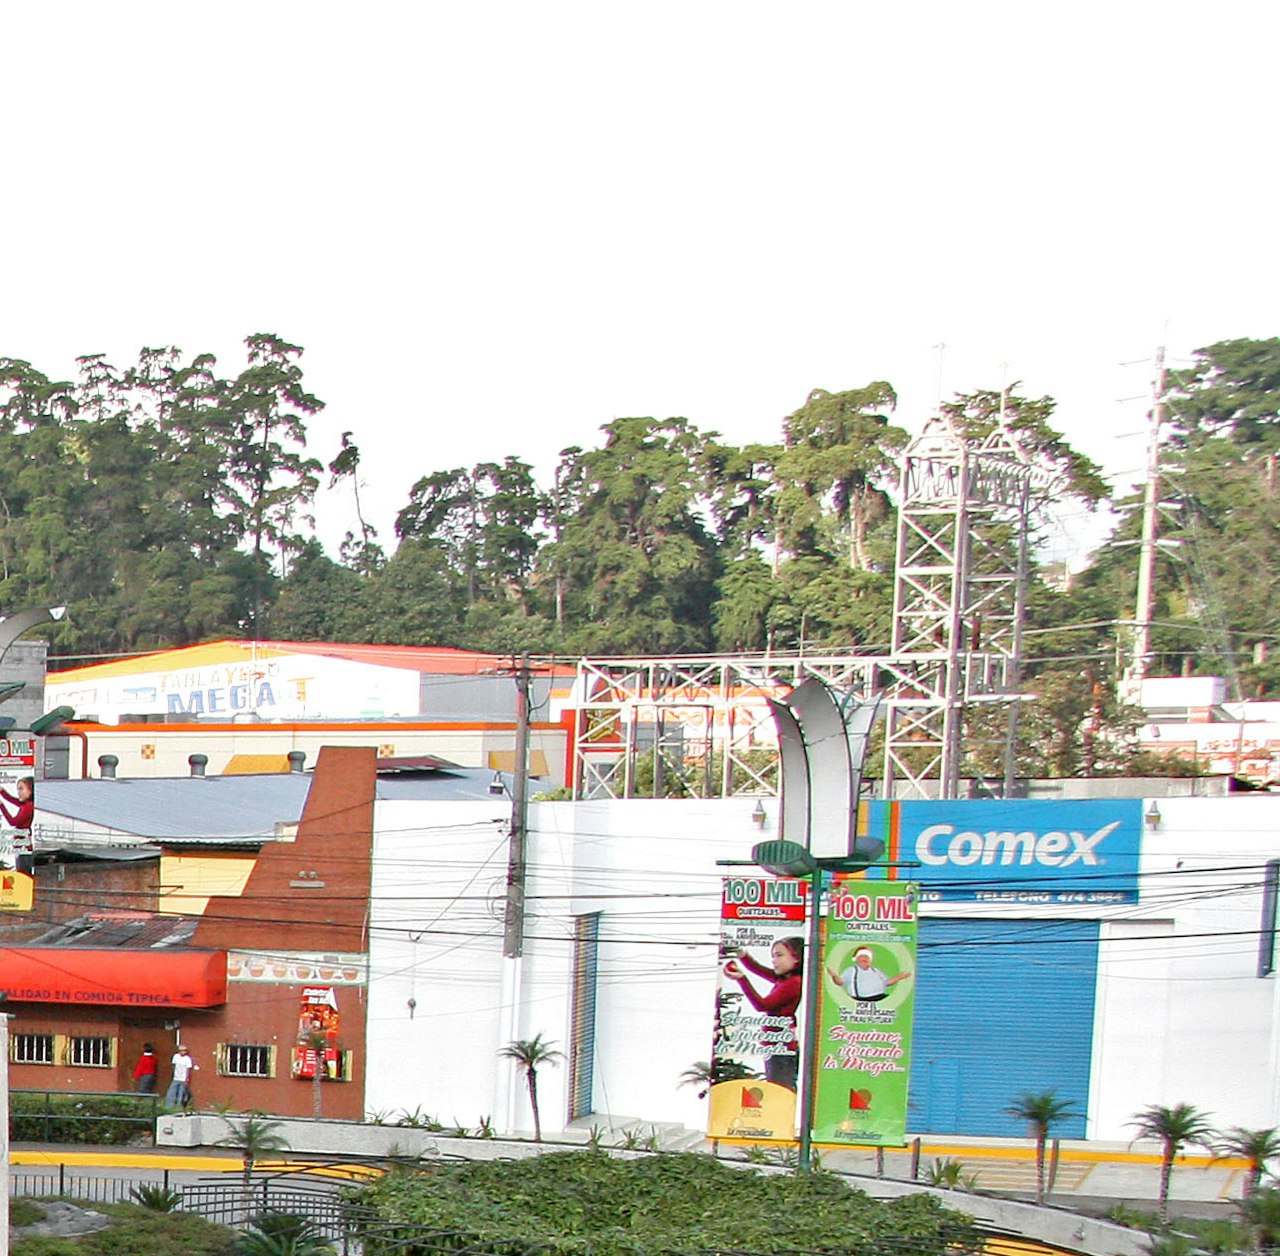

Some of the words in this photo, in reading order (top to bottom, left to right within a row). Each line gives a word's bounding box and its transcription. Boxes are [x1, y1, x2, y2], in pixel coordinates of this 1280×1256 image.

[915, 820, 1122, 868] Comex
[723, 880, 761, 905] 100
[764, 880, 805, 906] MIL
[831, 894, 871, 920] 100
[875, 896, 917, 922] MIL
